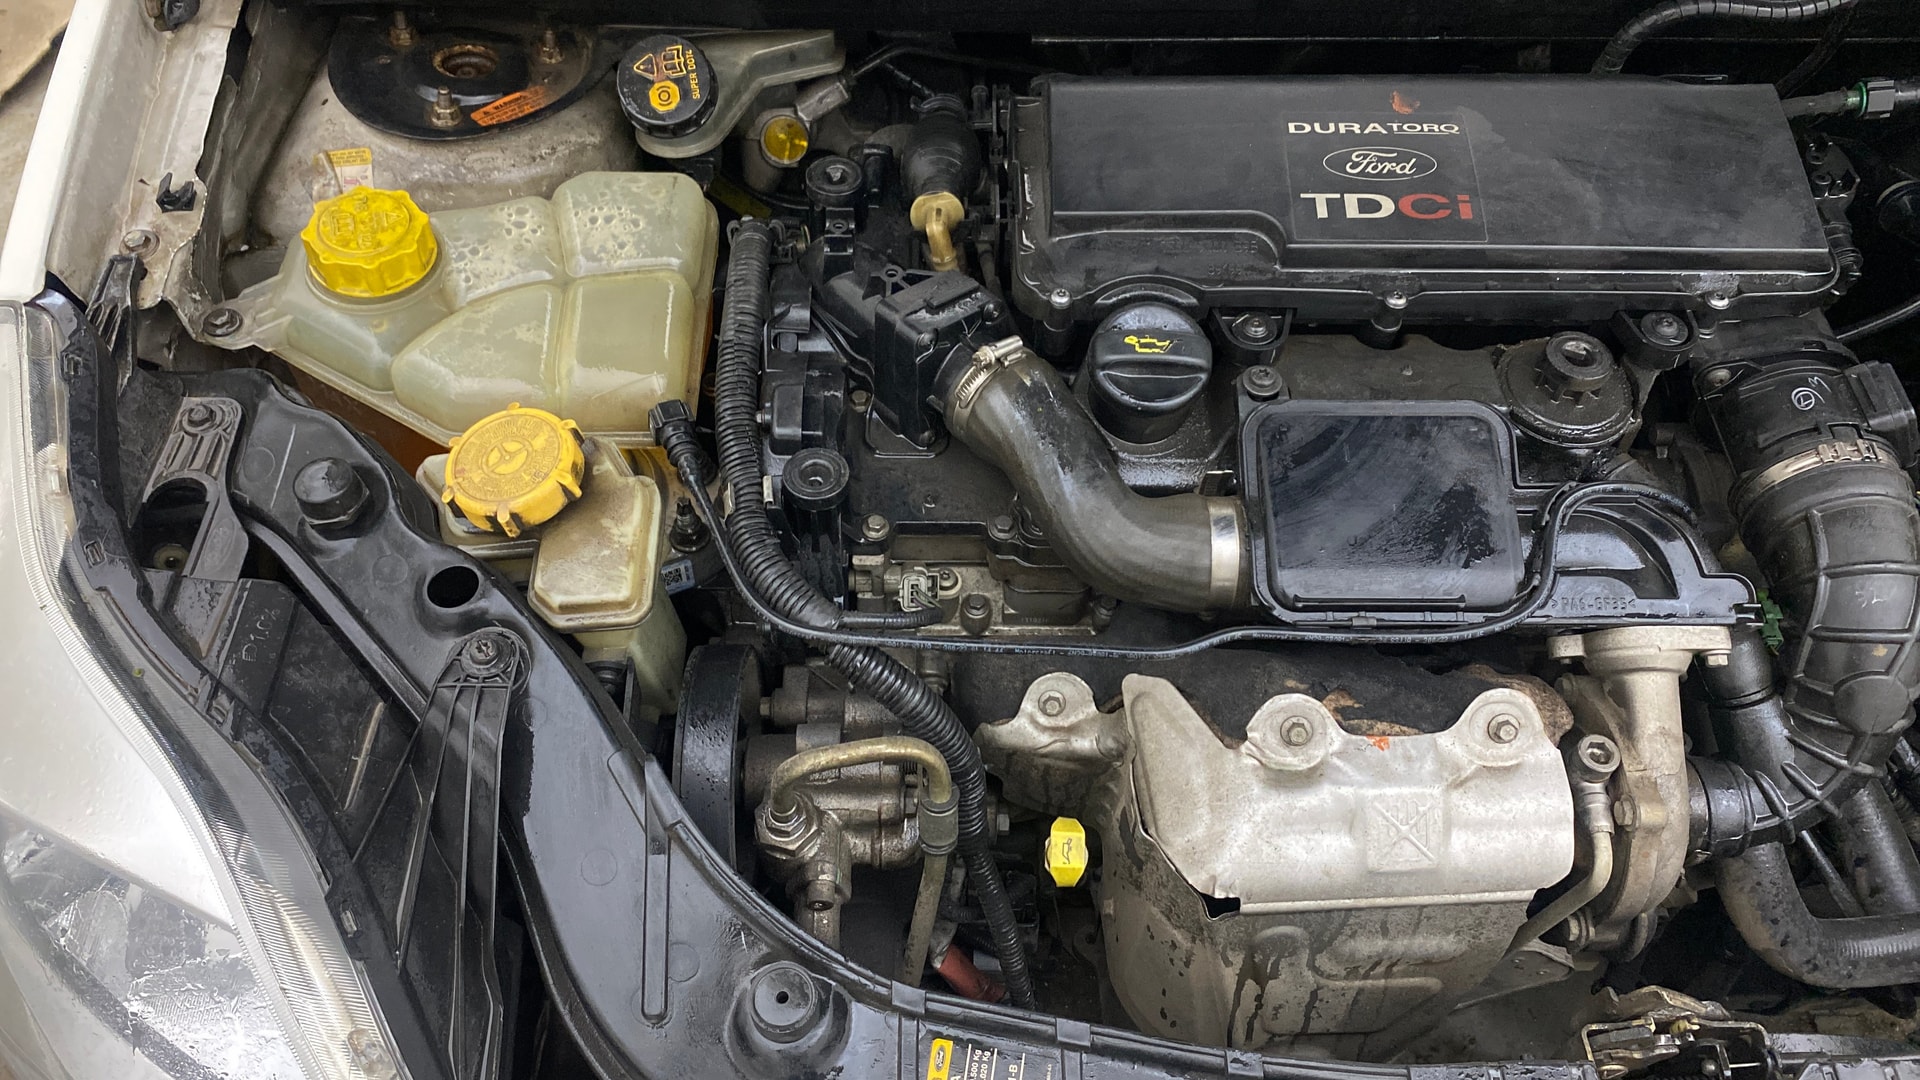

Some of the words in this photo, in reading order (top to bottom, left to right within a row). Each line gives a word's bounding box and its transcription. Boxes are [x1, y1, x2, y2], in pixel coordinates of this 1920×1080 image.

[685, 49, 696, 70] DOT4
[689, 72, 700, 99] SUPER
[1287, 122, 1460, 135] DURATORQ
[1345, 150, 1417, 175] Ford
[1300, 193, 1473, 220] TDCi
[973, 1049, 982, 1061] Kg
